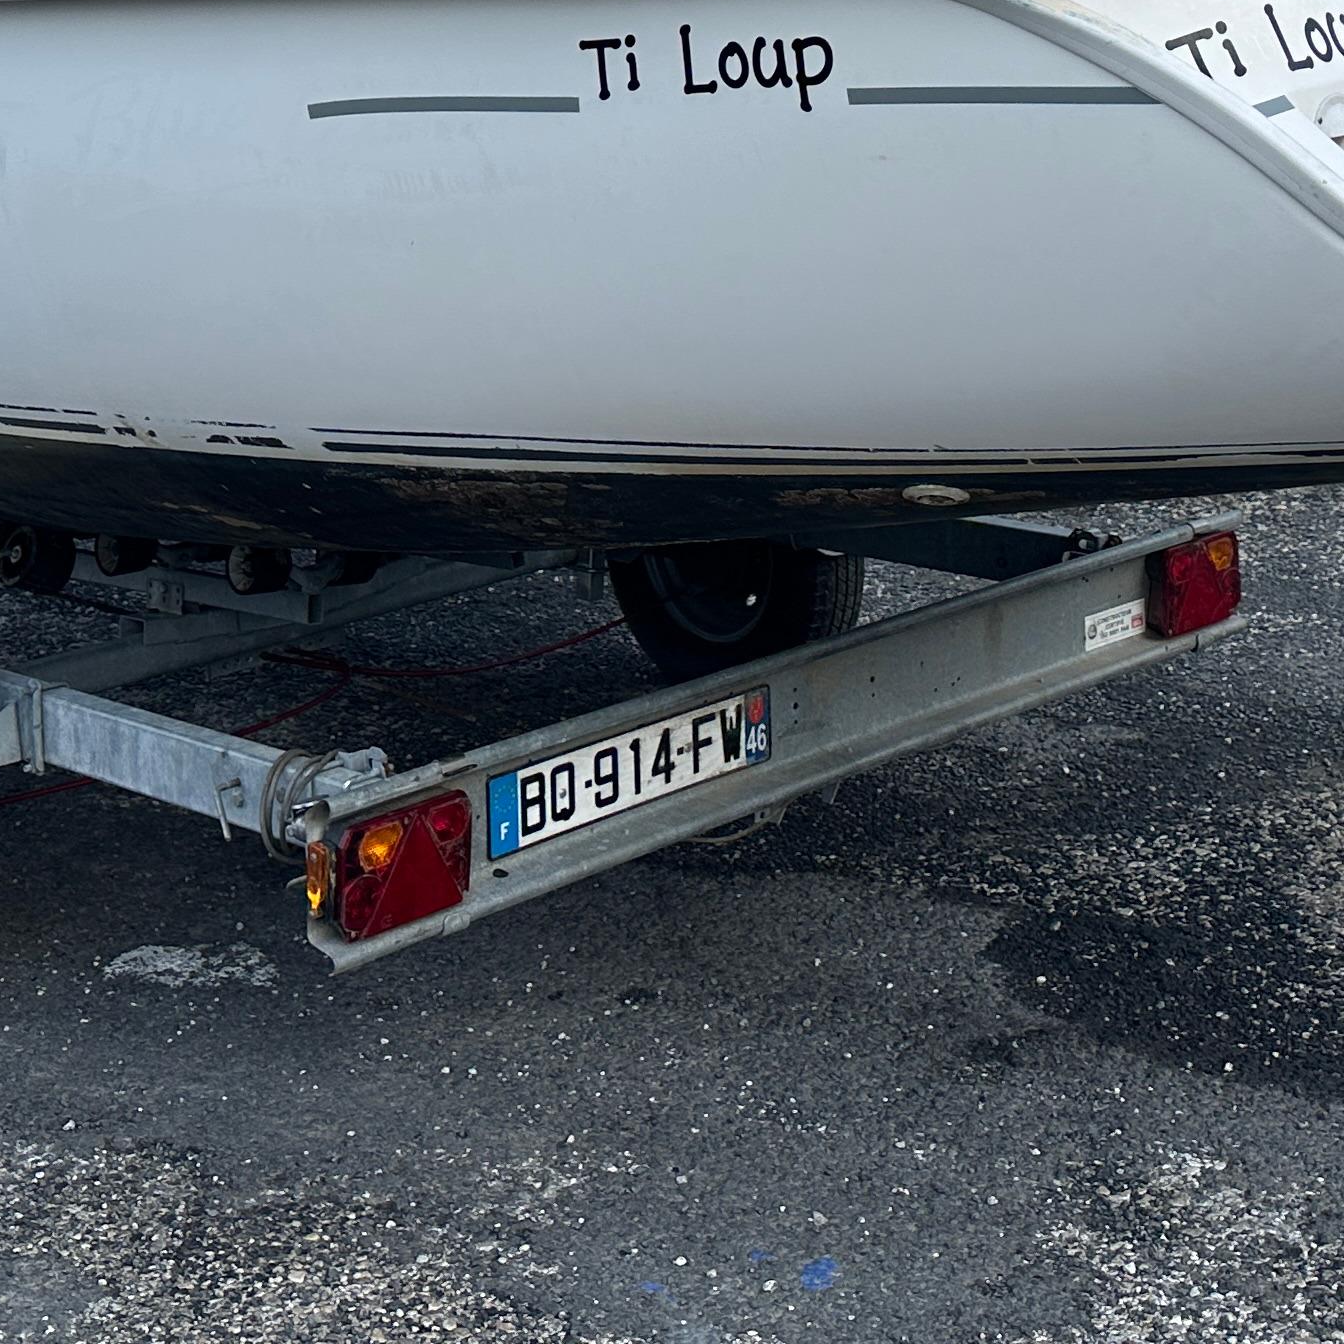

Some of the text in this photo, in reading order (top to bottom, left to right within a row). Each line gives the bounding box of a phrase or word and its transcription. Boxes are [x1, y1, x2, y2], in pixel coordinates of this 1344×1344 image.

[579, 24, 833, 112] Ti Loup
[1165, 21, 1247, 80] Ti
[500, 703, 743, 841] F BQ-914-FW
[746, 723, 767, 754] 46
